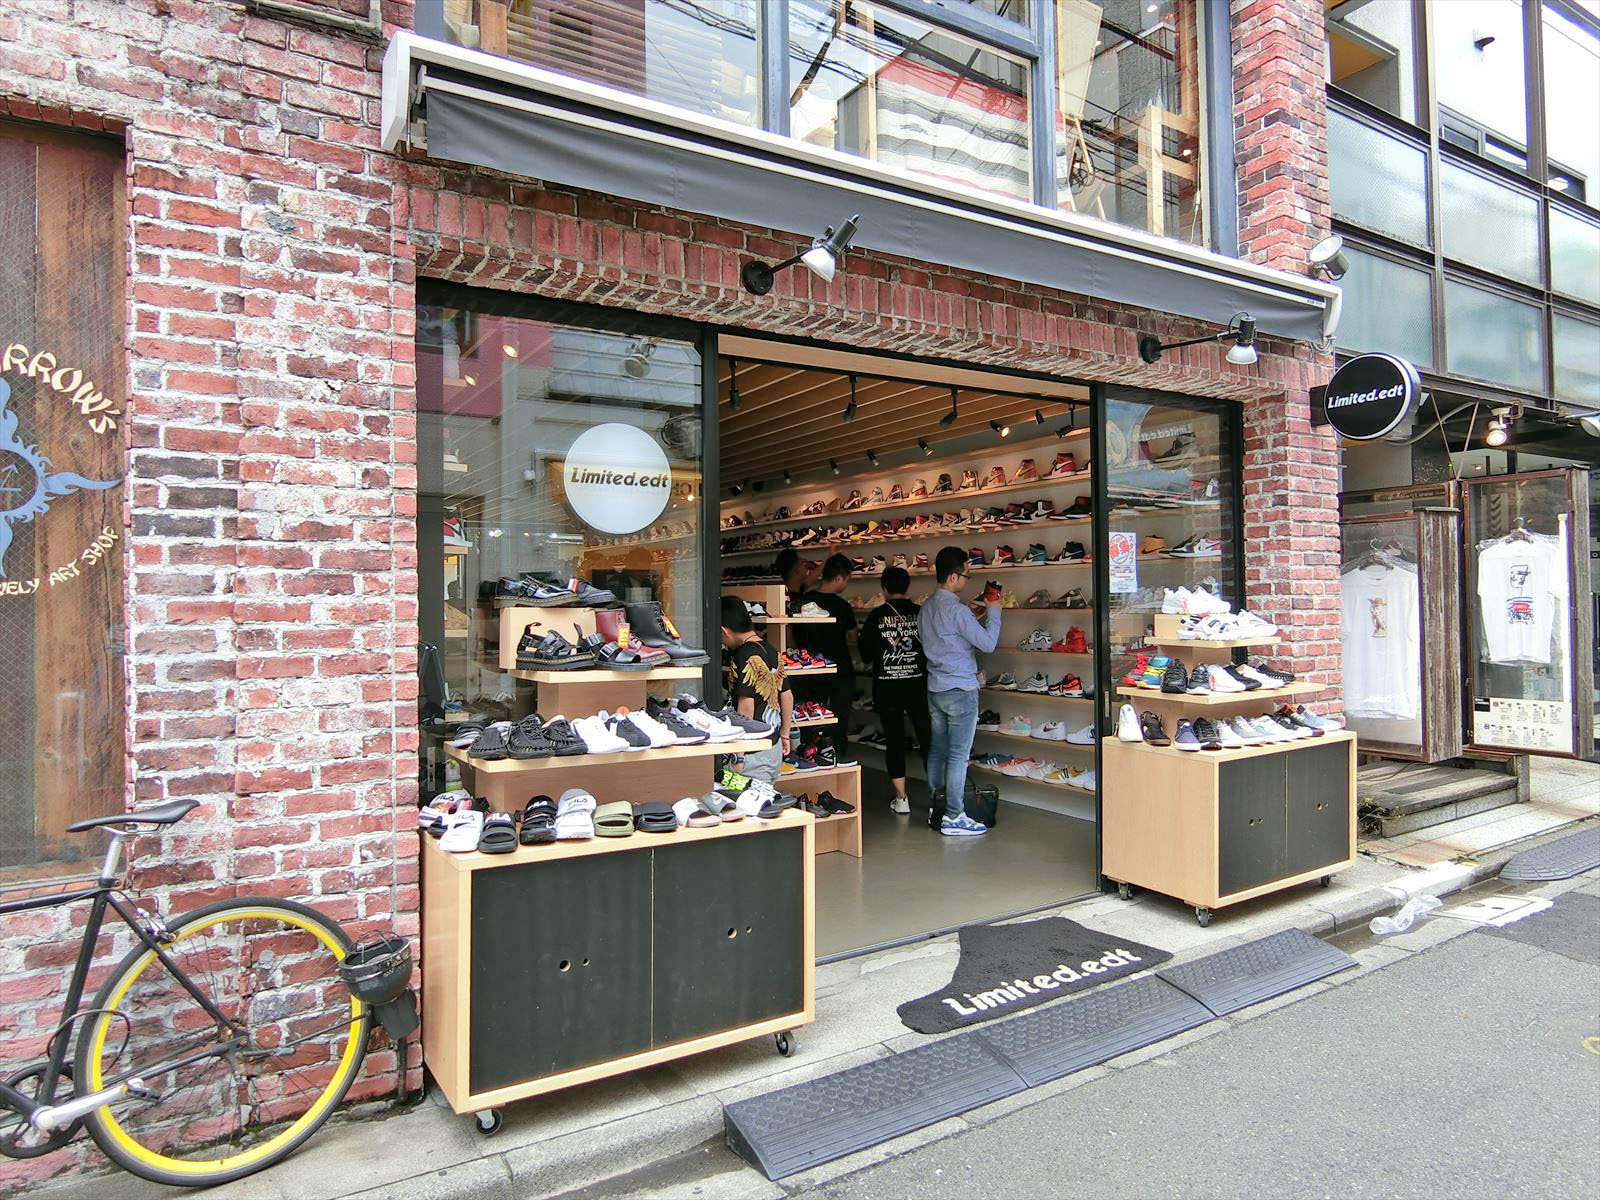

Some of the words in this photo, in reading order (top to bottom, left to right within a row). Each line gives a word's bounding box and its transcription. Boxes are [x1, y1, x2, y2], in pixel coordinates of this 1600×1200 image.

[0, 342, 121, 435] RROW'S
[1327, 383, 1405, 409] Limited.edt
[571, 467, 669, 488] Limited.edt
[48, 558, 80, 587] ART
[81, 526, 119, 566] SHOP
[900, 629, 918, 637] YORK
[942, 948, 1142, 1016] Limited.edt
